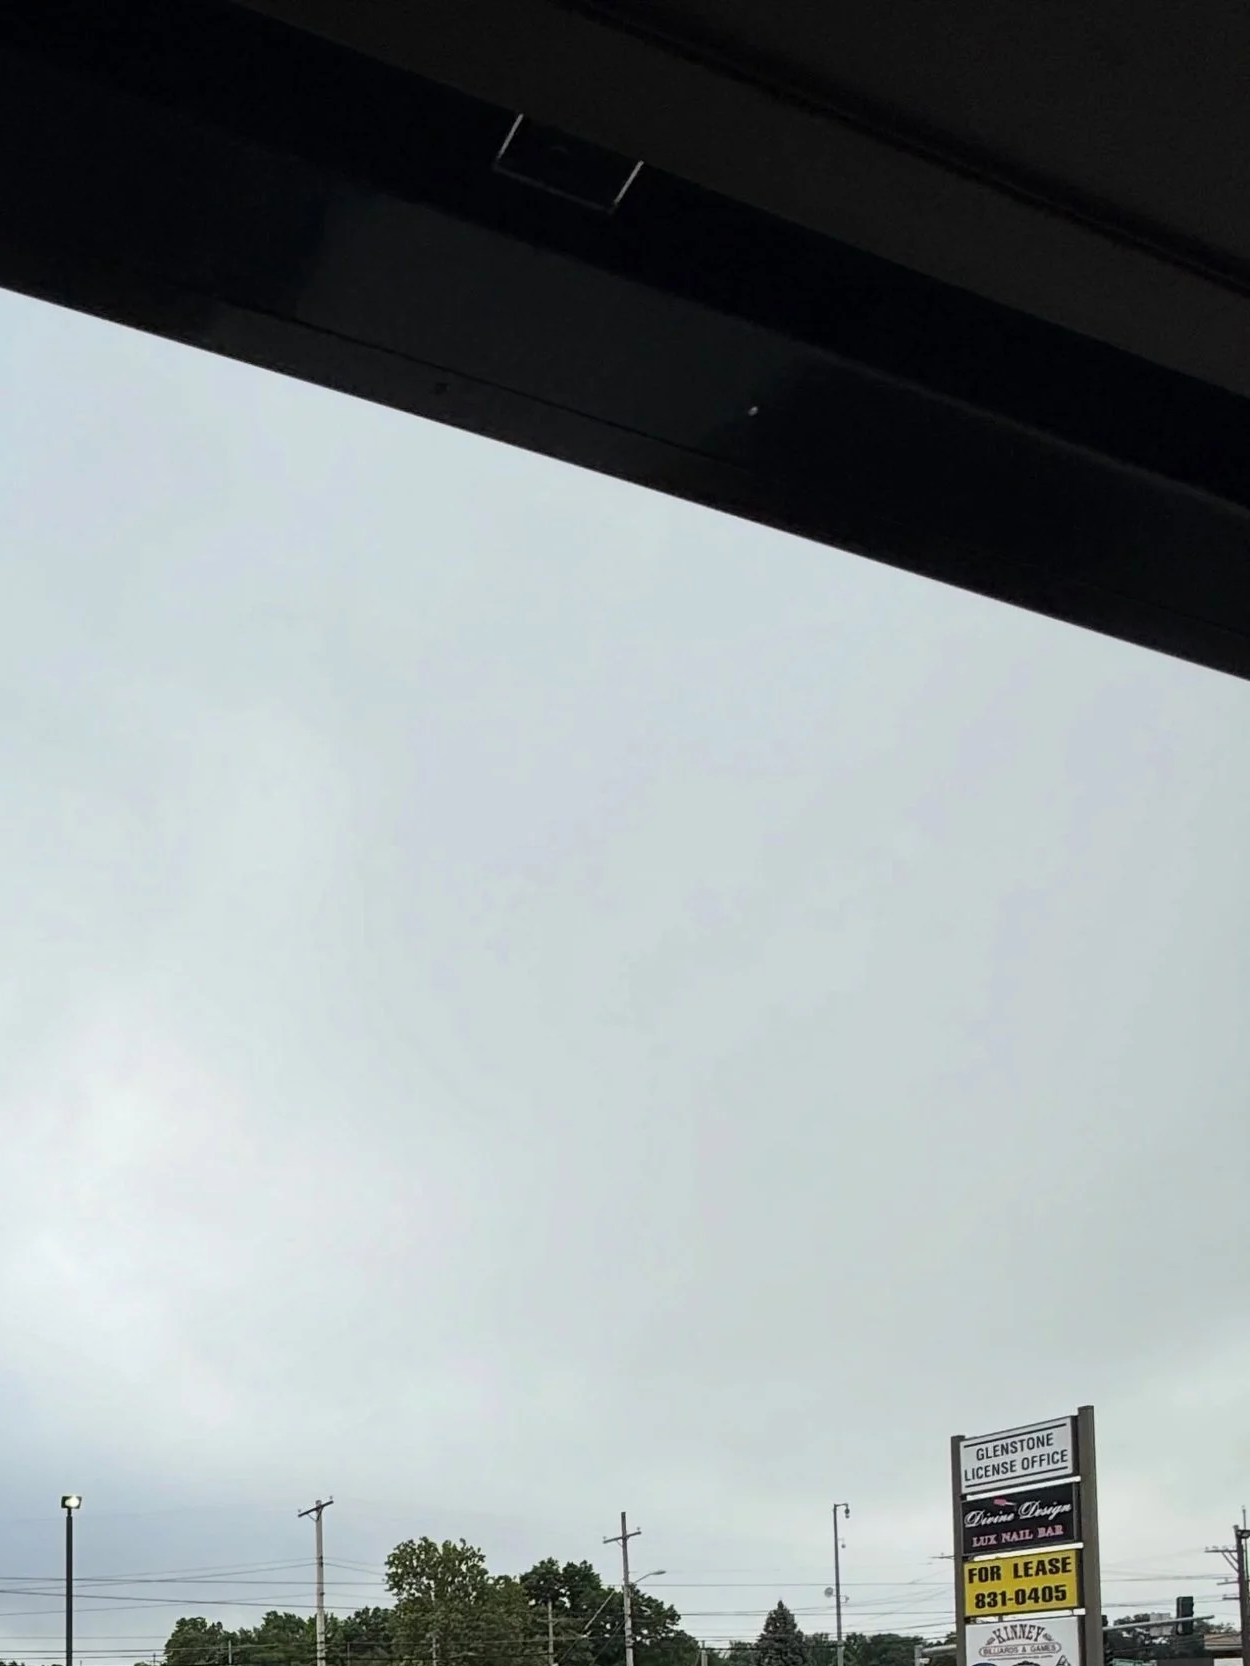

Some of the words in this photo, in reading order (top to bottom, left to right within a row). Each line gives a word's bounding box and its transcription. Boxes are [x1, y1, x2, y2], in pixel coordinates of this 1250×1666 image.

[976, 1432, 1054, 1462] GLENSTONE
[964, 1460, 1017, 1482] LICENSE
[1021, 1449, 1069, 1471] OFFICE
[964, 1509, 1015, 1528] Divine
[1018, 1500, 1072, 1521] Design
[972, 1534, 998, 1548] LUX
[1001, 1529, 1034, 1544] NAIL
[1037, 1524, 1064, 1539] BAR
[967, 1565, 1002, 1584] FOR
[1013, 1557, 1073, 1579] LEASE
[974, 1584, 1068, 1609] 831-0405
[992, 1623, 1047, 1645] KINNEY
